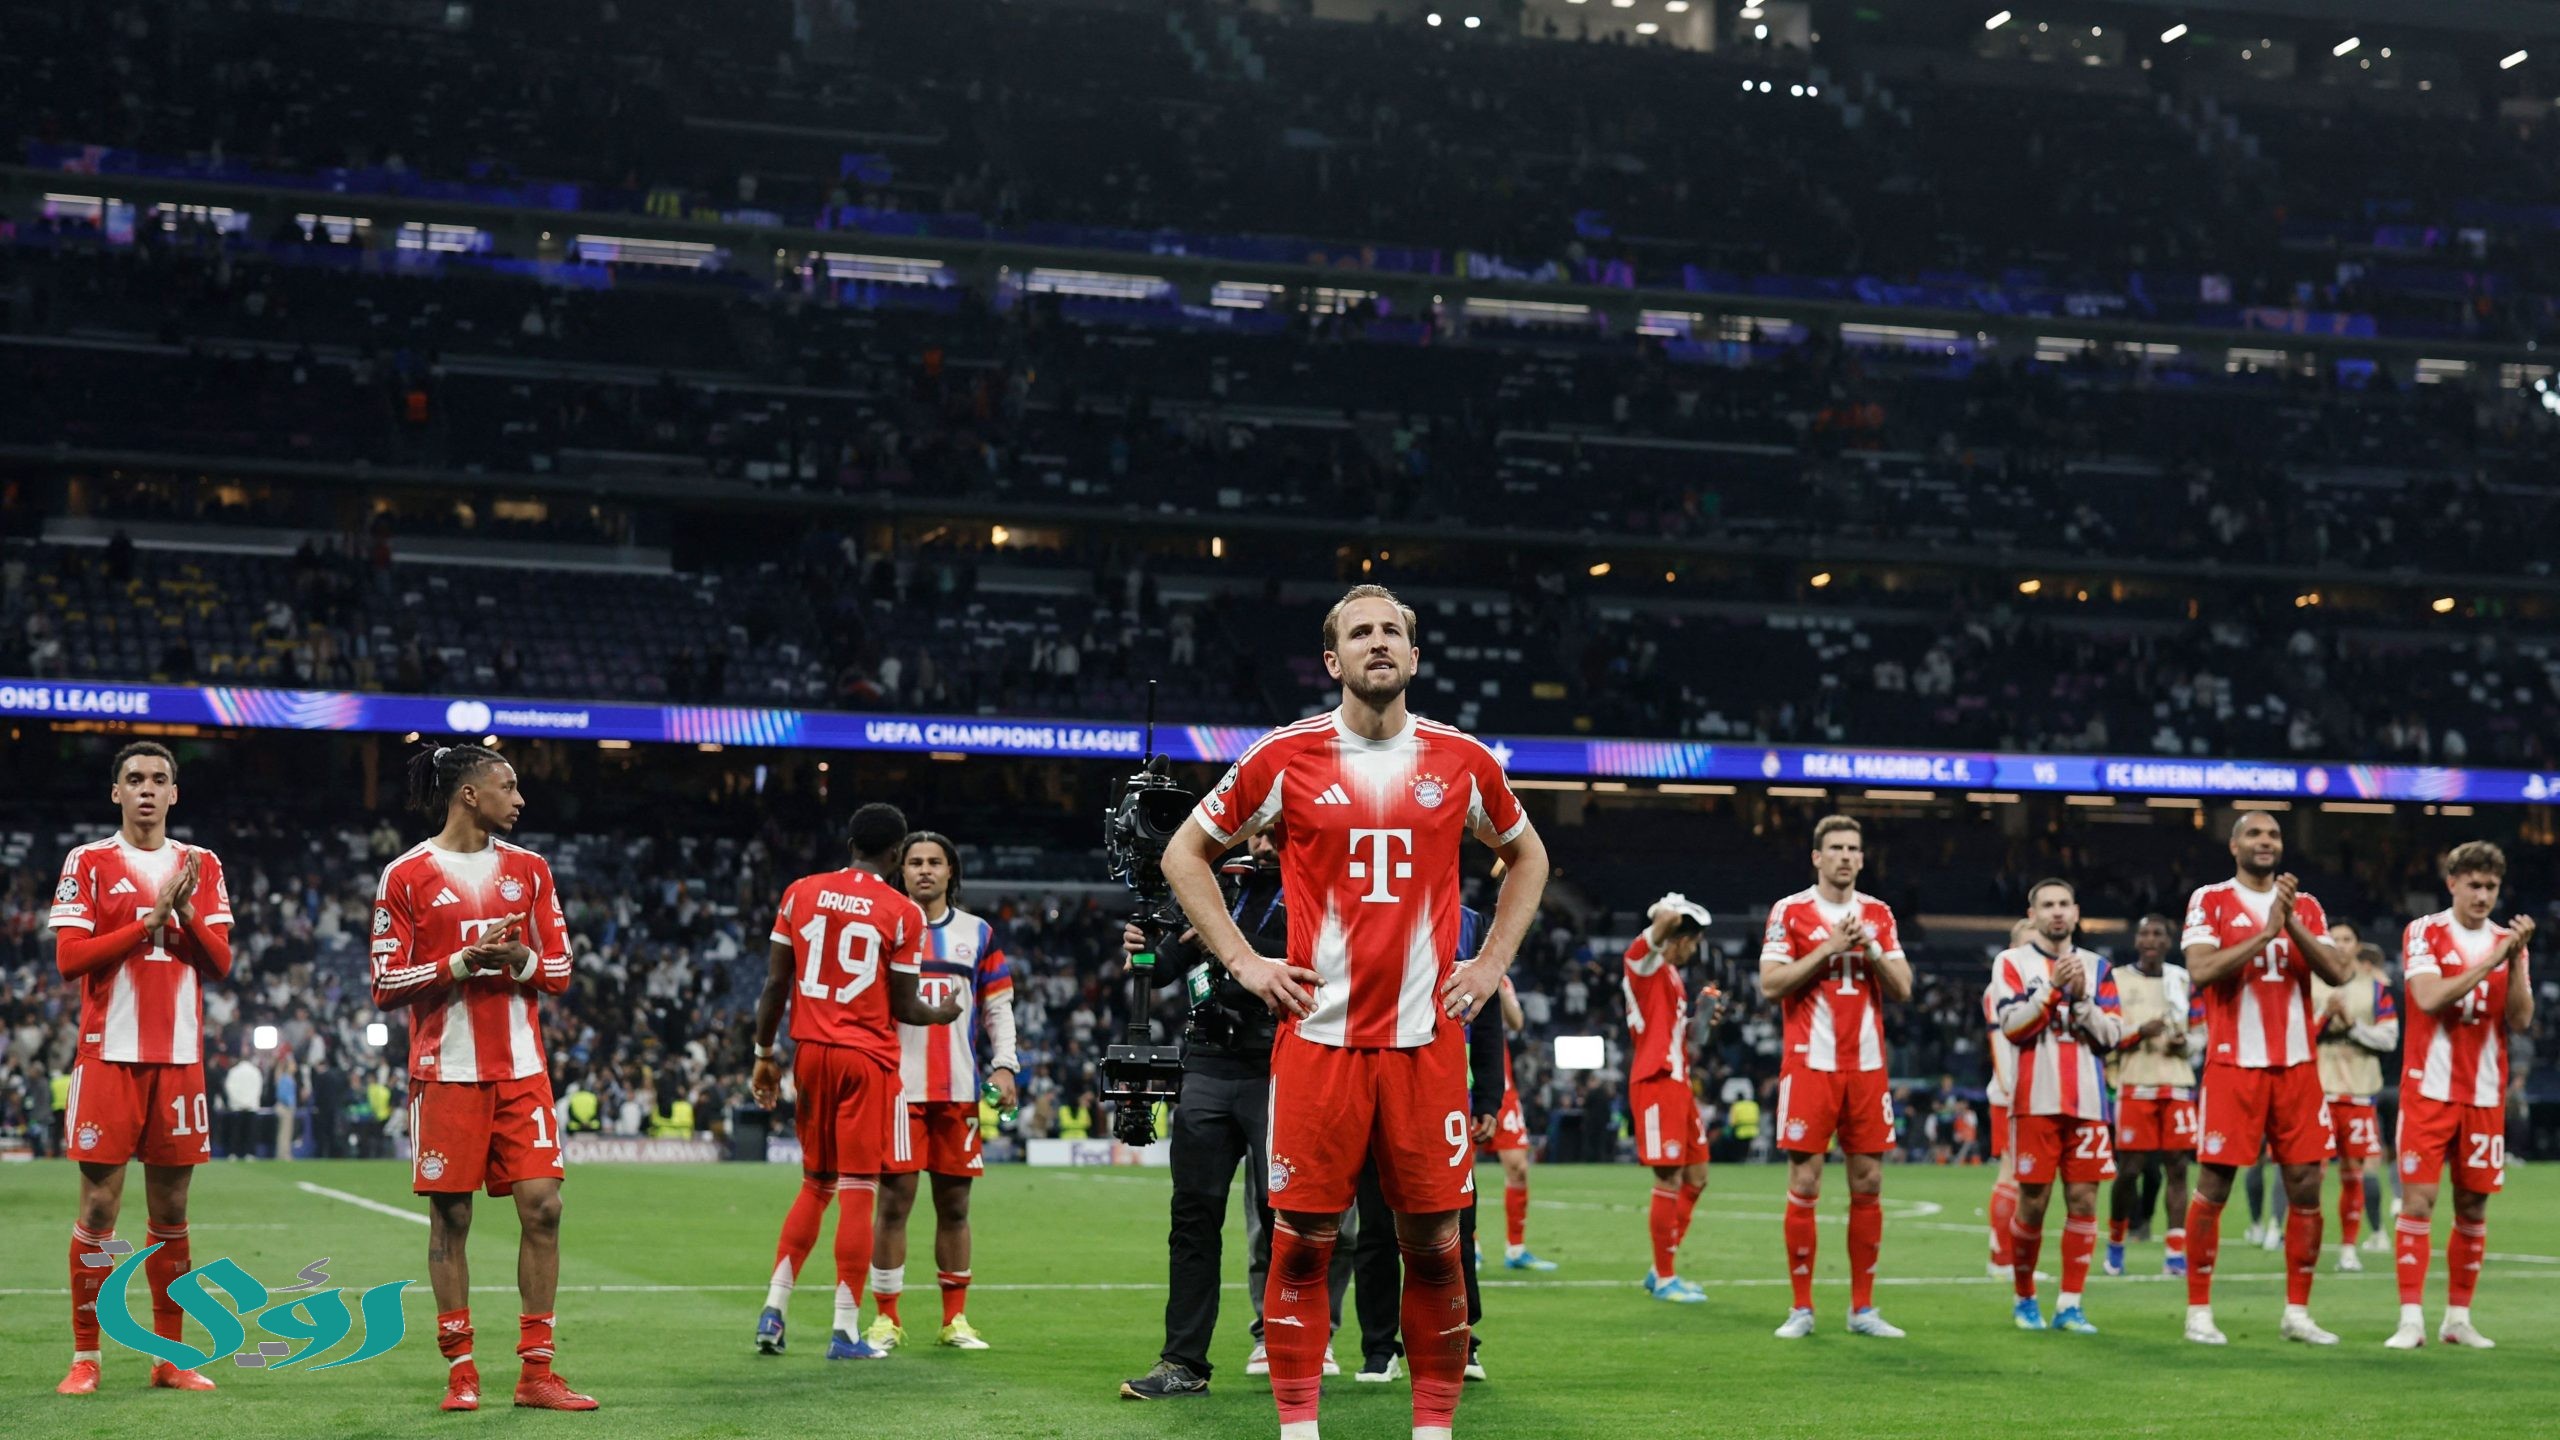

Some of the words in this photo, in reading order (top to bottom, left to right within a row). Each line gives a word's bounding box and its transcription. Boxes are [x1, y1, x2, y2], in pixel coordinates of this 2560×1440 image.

[53, 688, 149, 714] LEAGUE
[865, 721, 923, 744] UEFA
[924, 723, 1055, 750] CHAMPIONS
[1056, 728, 1141, 752] LEAGUE
[1802, 753, 1852, 777] REAL
[1853, 755, 1932, 780] MADRID
[2106, 763, 2132, 786] FC
[2132, 765, 2204, 788] BAYERN
[2205, 762, 2298, 792] MÜNCHEN
[1349, 828, 1412, 903] T
[817, 889, 874, 917] DAVIES
[799, 913, 882, 1005] 19
[171, 1092, 209, 1136] 10
[530, 1106, 561, 1149] 1
[2174, 1109, 2197, 1134] 11
[2349, 1117, 2377, 1144] 21
[964, 1116, 980, 1153] 7
[1444, 1110, 1469, 1168] 9
[2075, 1126, 2111, 1159] 22
[2467, 1133, 2505, 1169] 20
